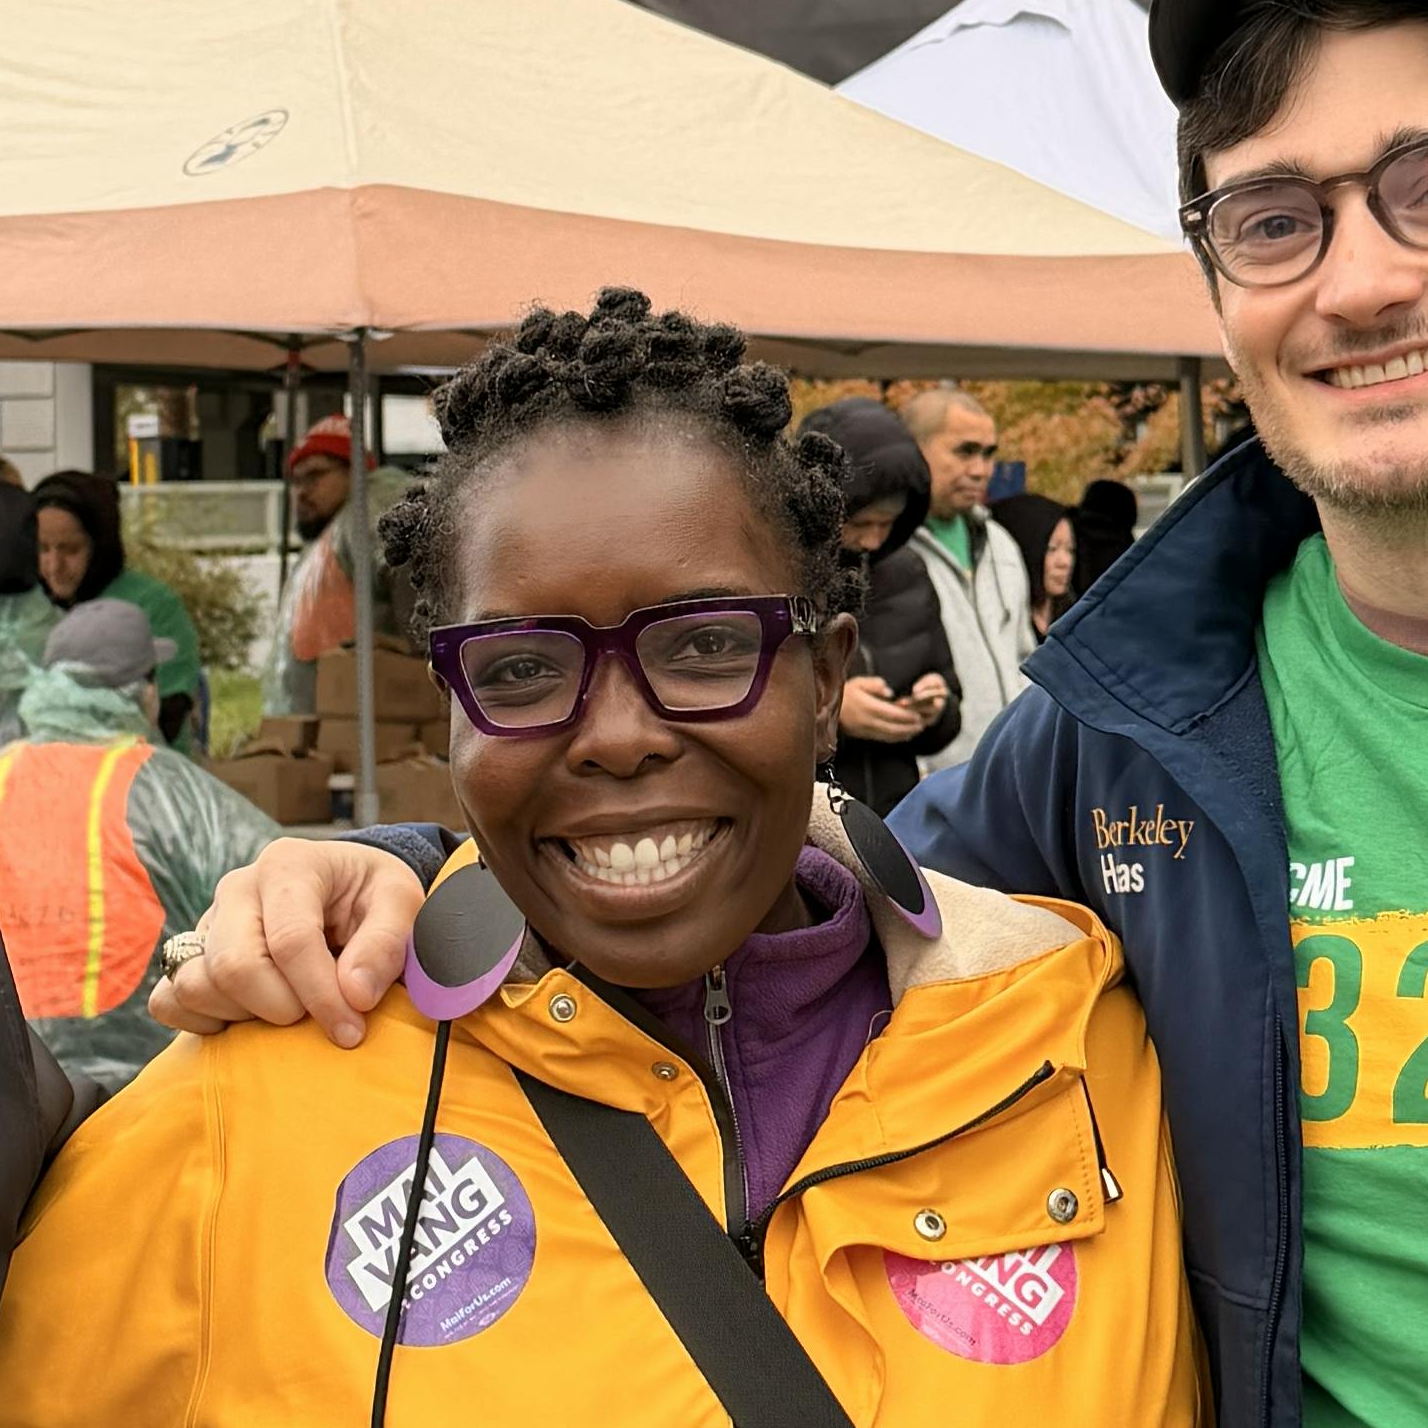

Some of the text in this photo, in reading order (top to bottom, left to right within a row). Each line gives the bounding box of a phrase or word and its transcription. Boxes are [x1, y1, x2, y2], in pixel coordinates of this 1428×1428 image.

[1091, 803, 1195, 860] Berkeley
[1289, 856, 1355, 911] CME
[410, 1209, 513, 1301] CONGRESS
[933, 1259, 1034, 1336] ONGRESS
